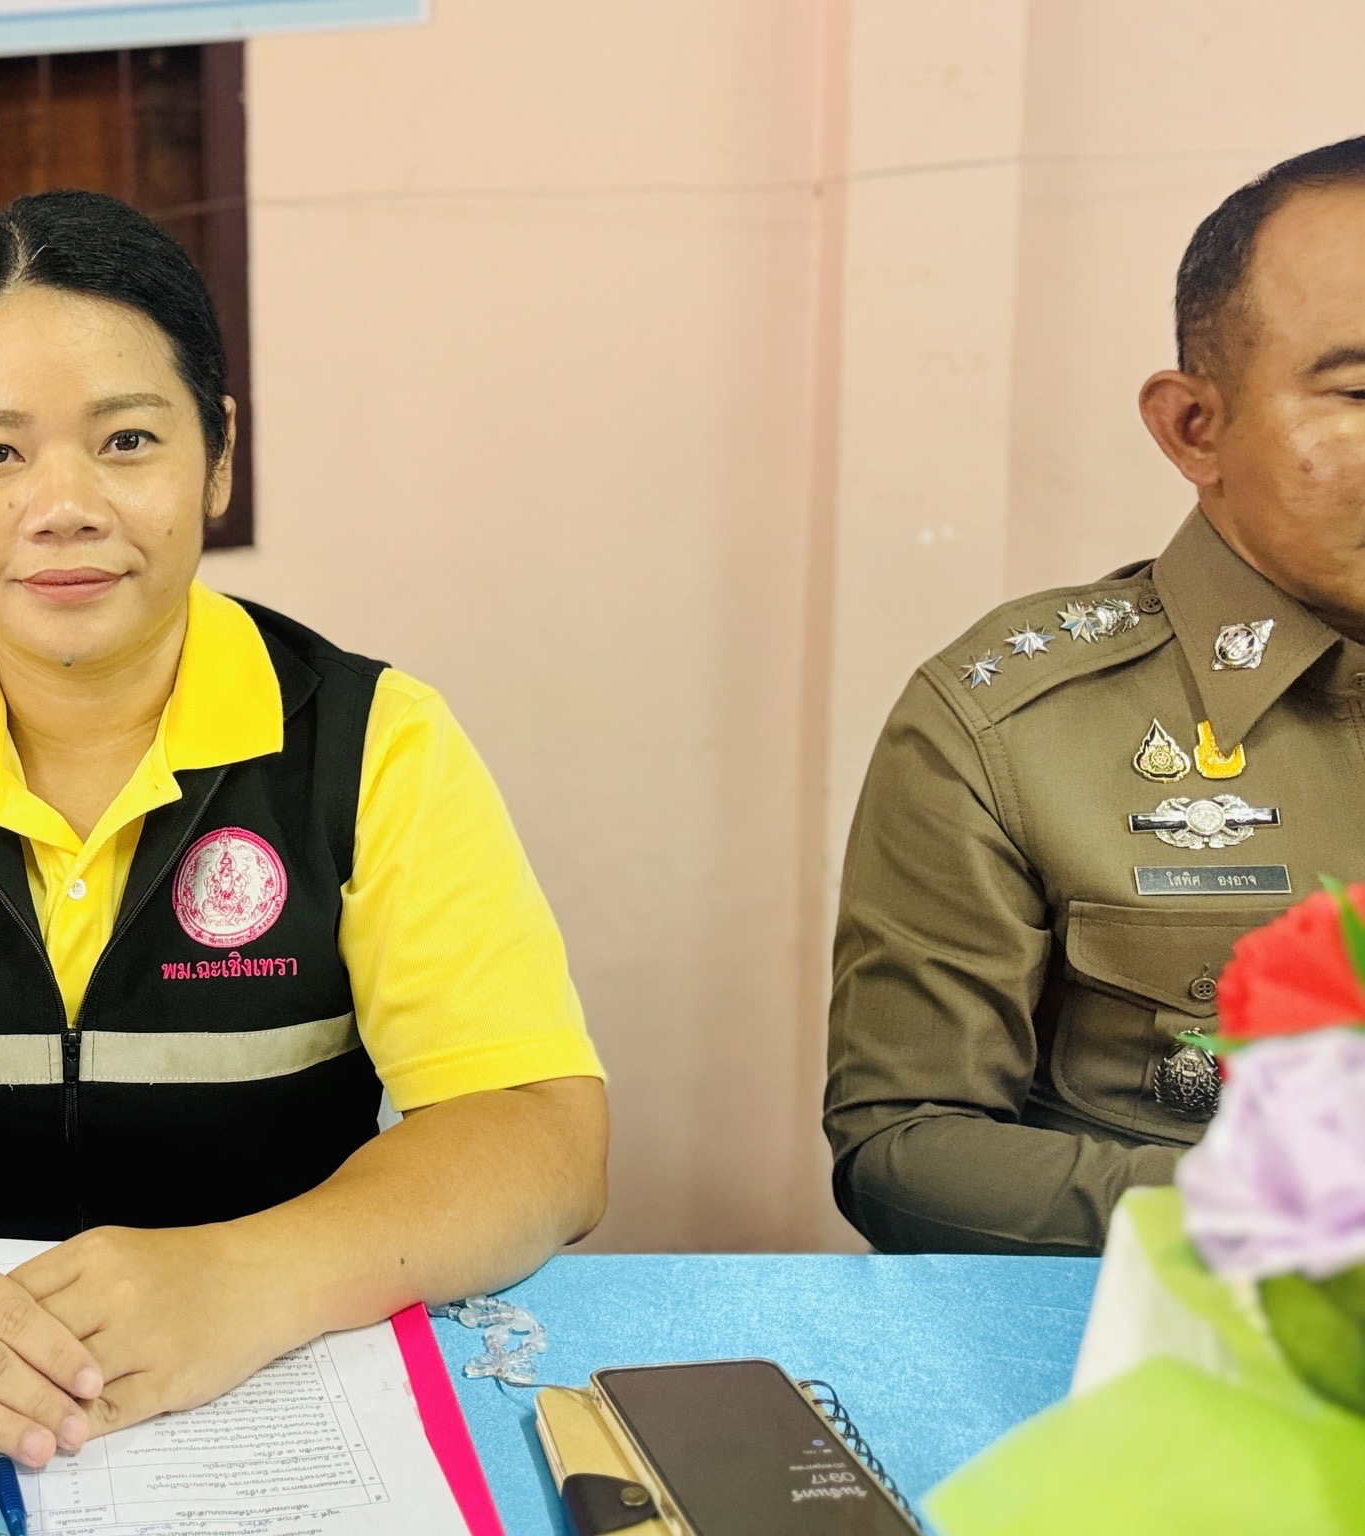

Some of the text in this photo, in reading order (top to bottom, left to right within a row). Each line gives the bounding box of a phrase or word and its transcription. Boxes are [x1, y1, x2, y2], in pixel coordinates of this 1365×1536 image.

[161, 951, 298, 980] พม.ฉะเชิงเทรา
[810, 1471, 856, 1485] 09:17
